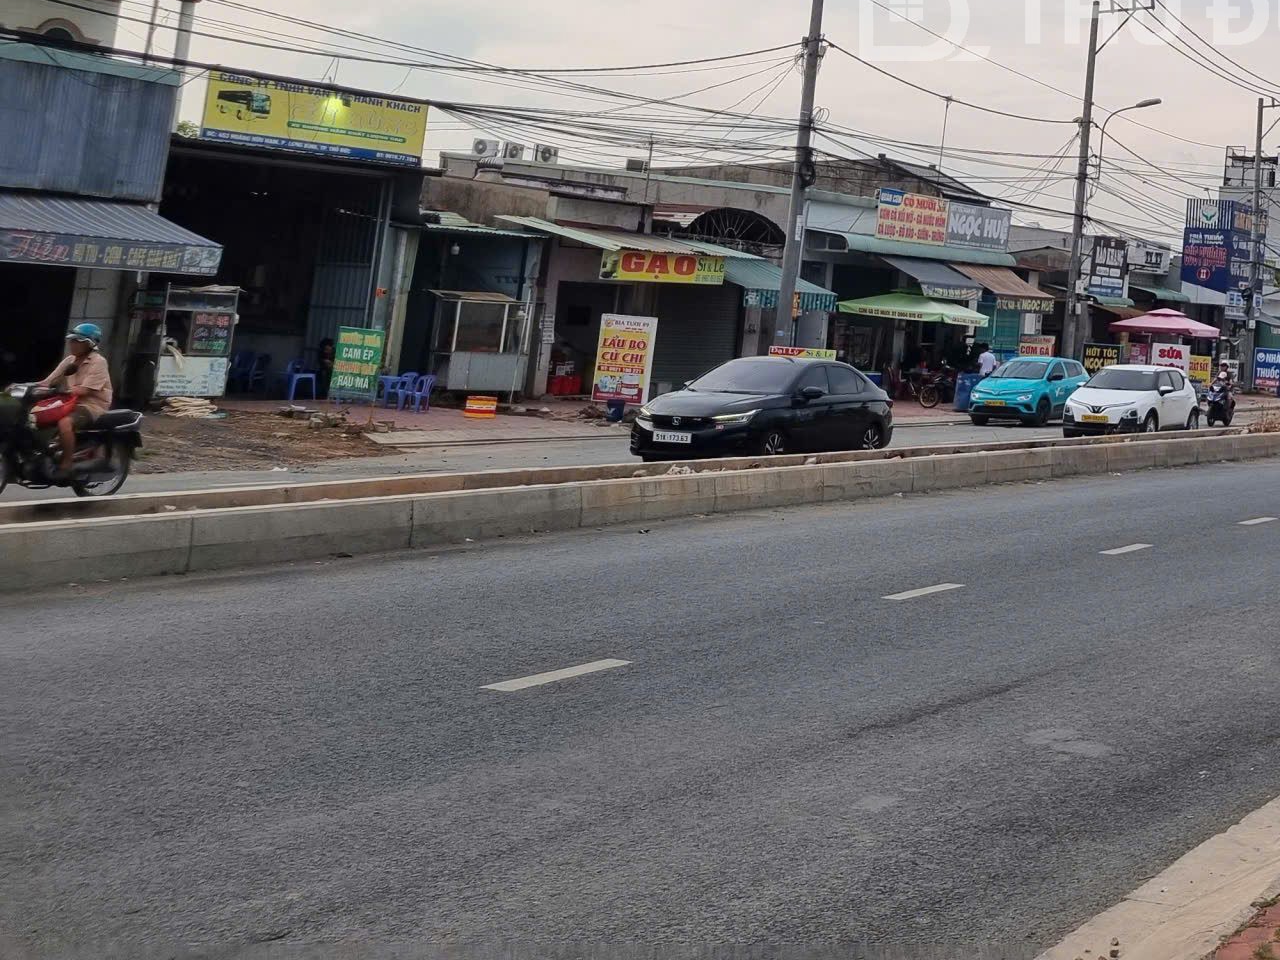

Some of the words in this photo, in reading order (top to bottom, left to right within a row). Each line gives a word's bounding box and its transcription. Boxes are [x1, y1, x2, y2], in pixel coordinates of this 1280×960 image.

[948, 212, 982, 241] NGỌC
[621, 251, 697, 280] GẠO
[342, 347, 361, 359] CAM
[1266, 352, 1280, 364] NHÀ
[1256, 365, 1280, 379] THUỐC
